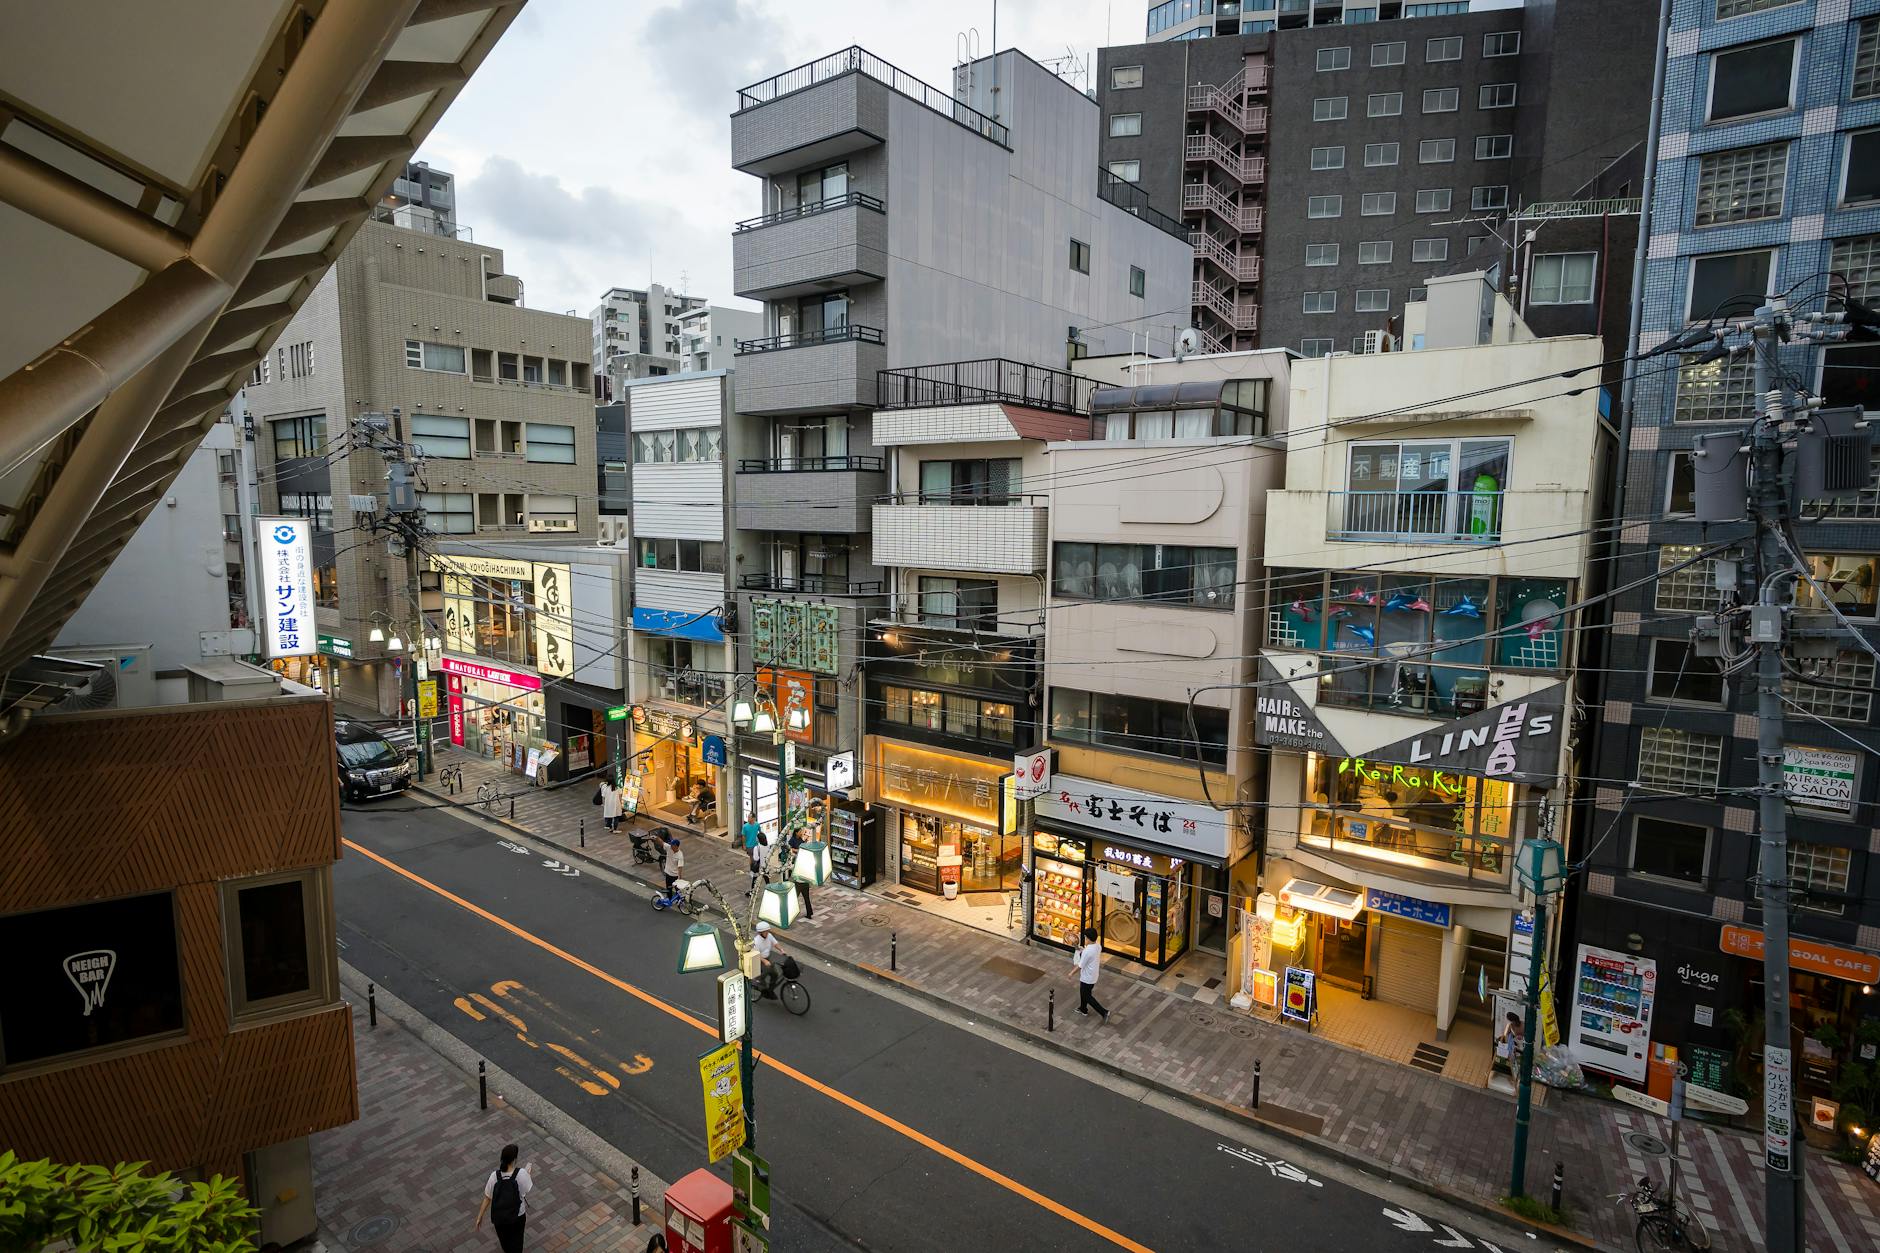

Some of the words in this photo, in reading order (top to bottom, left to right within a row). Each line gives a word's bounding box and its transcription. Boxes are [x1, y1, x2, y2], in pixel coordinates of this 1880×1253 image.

[1353, 457, 1421, 479] 不動産
[276, 549, 292, 583] 株式会社
[469, 561, 526, 576] YOYOGIHACHIMAN
[295, 546, 309, 617] 街の身近な建設会社
[275, 584, 300, 650] サン建設
[455, 663, 486, 677] NATURAL
[1257, 696, 1292, 717] HAIR
[1292, 706, 1301, 718] &
[1265, 715, 1307, 737] MAKE
[1307, 727, 1323, 739] the
[1484, 702, 1528, 777] HEAD
[1804, 751, 1820, 759] Cut
[1804, 758, 1820, 767] Spa
[1823, 770, 1839, 778] 2F
[1801, 784, 1850, 799] SALON
[1059, 790, 1082, 815] 名代
[1084, 793, 1176, 834] 富士そば
[1183, 818, 1197, 829] 24
[1103, 846, 1153, 869] 乱切り蕎麦
[1370, 896, 1446, 924] タイユーホーム
[72, 955, 109, 973] NEIGH
[1677, 963, 1720, 984] ajuga
[1833, 957, 1874, 974] CAFE
[79, 968, 105, 984] BAR
[1766, 1071, 1779, 1114] クリニック
[1778, 1073, 1790, 1112] いながき
